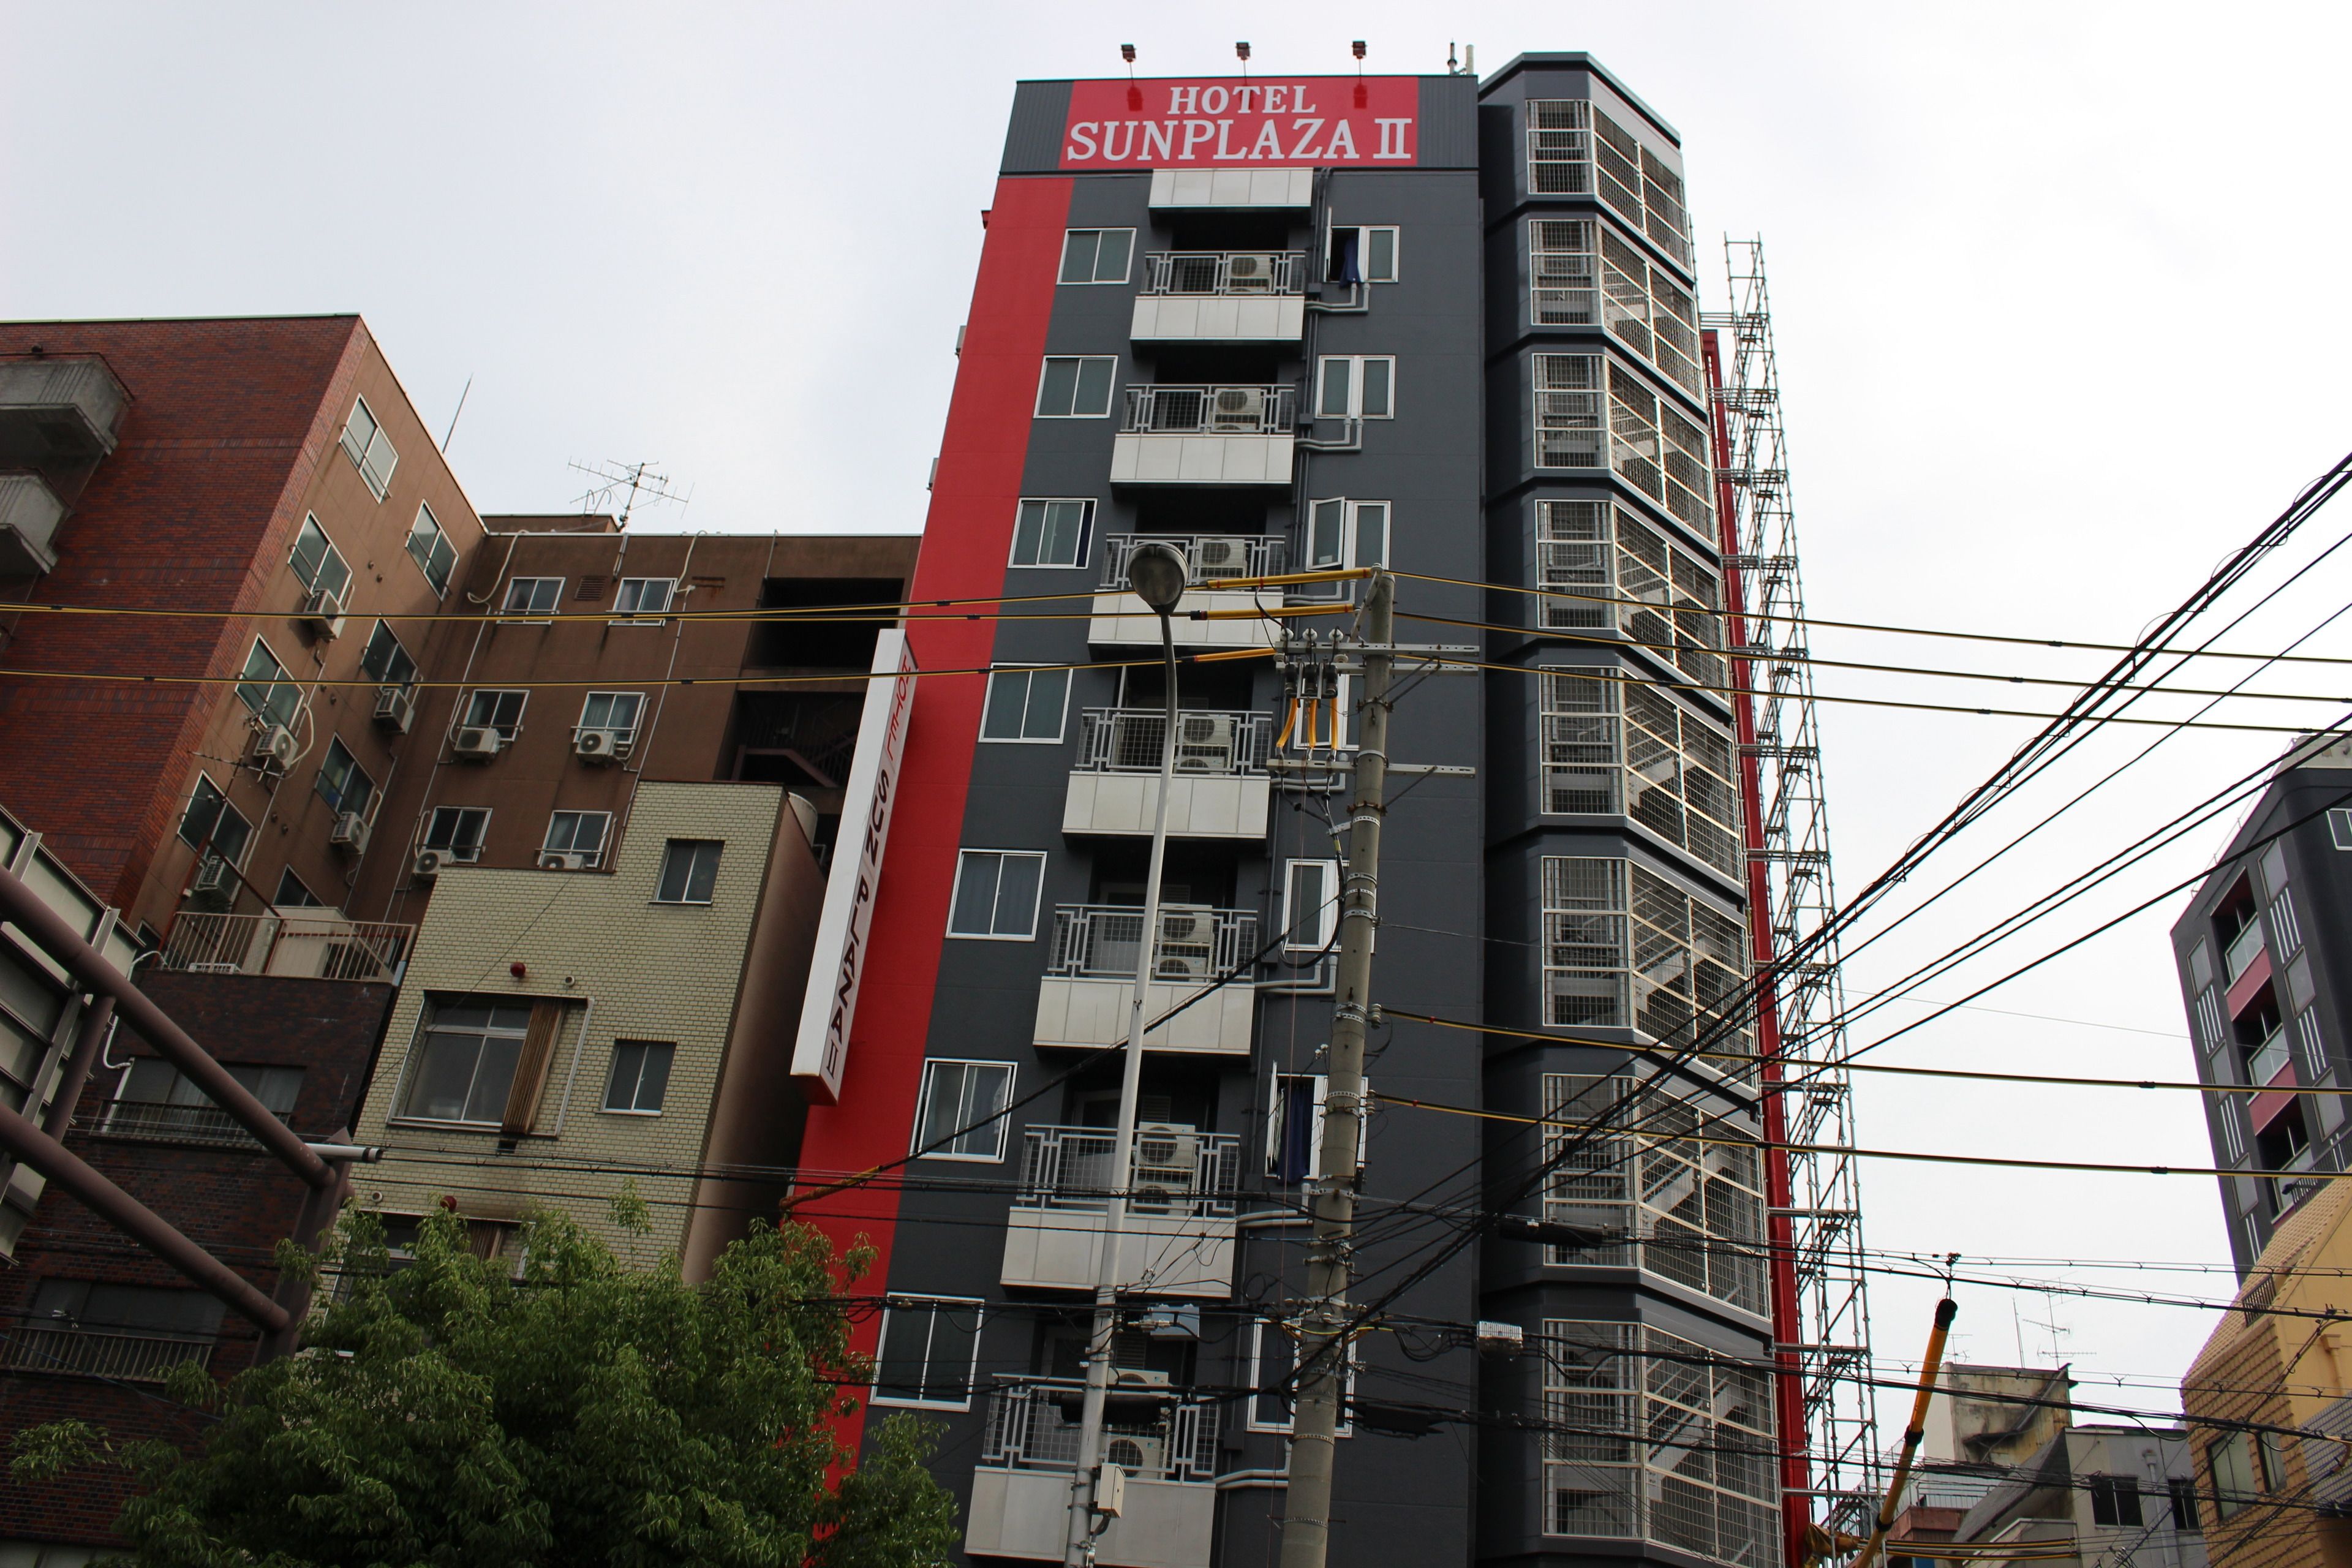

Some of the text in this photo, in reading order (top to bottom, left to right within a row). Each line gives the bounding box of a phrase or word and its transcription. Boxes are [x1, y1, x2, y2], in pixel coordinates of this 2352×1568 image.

[1167, 85, 1316, 115] HOTEL
[1067, 118, 1412, 161] SUNPLAZA II
[826, 654, 911, 1080] HOTEL SUN PLAZA II
